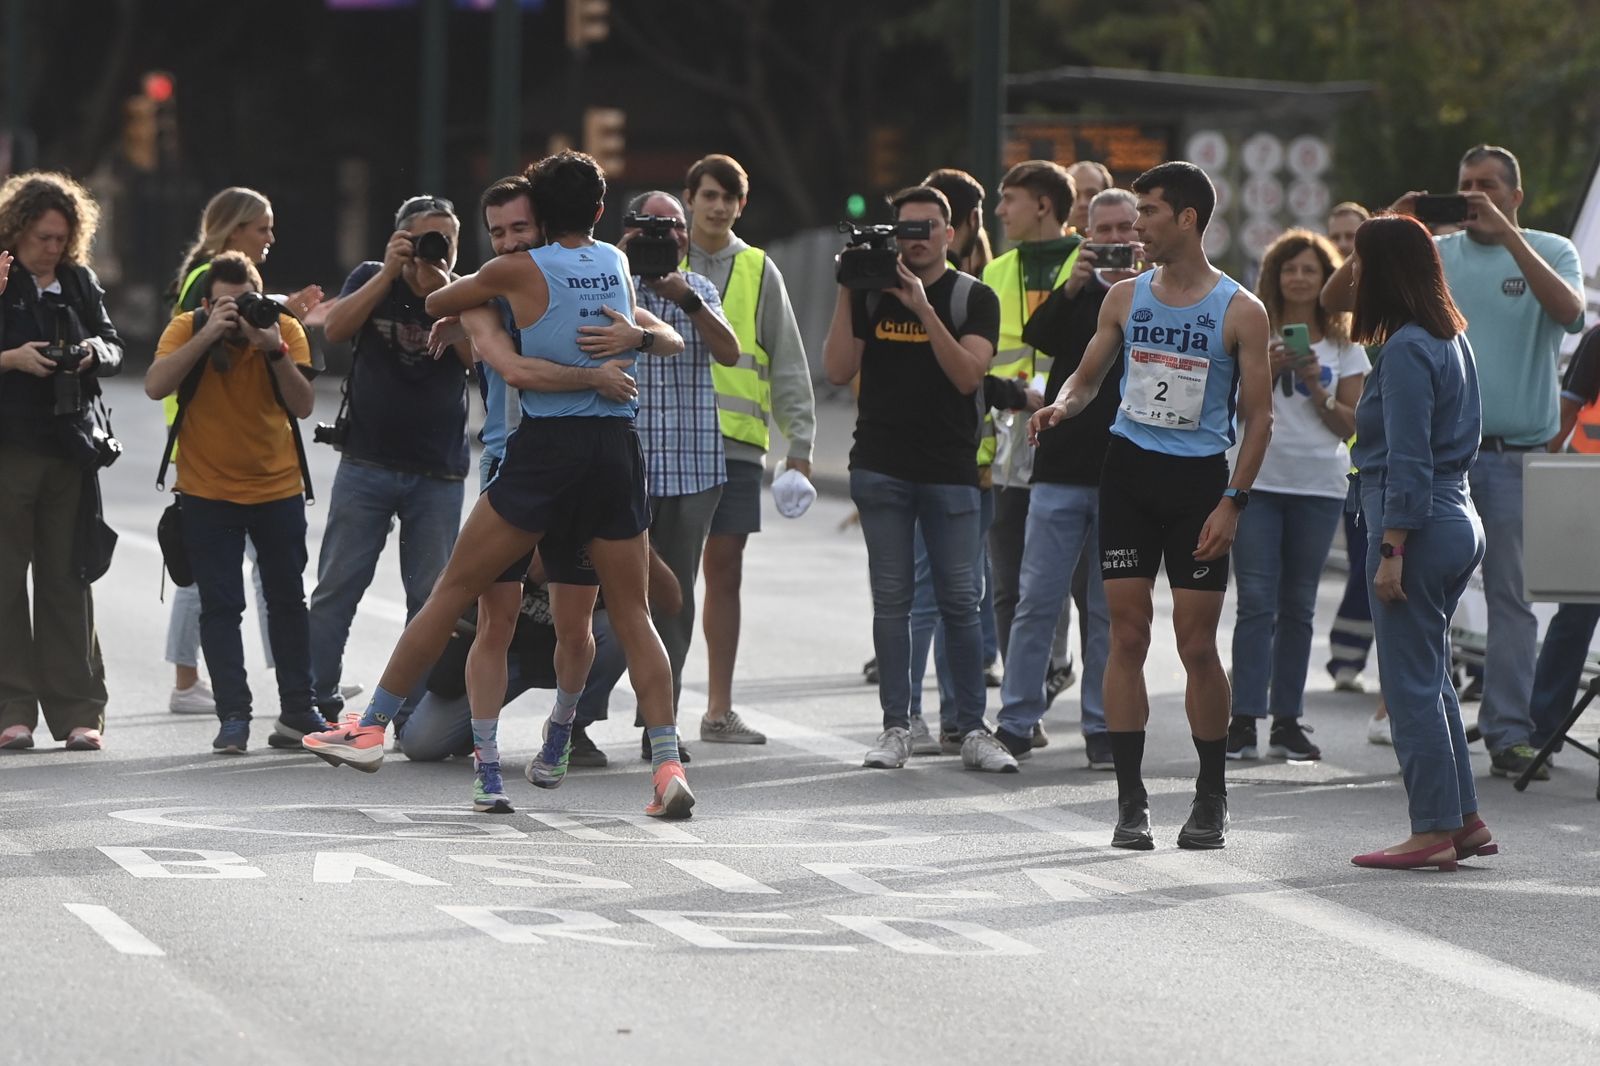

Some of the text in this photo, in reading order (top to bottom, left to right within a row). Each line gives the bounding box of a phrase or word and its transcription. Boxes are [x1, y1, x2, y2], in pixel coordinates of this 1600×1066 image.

[566, 273, 619, 291] nerja
[579, 292, 616, 301] ATLETISMO
[1132, 323, 1209, 353] nerja
[1154, 381, 1169, 402] 2
[1106, 560, 1139, 569] BEAST
[435, 904, 1045, 957] RED
